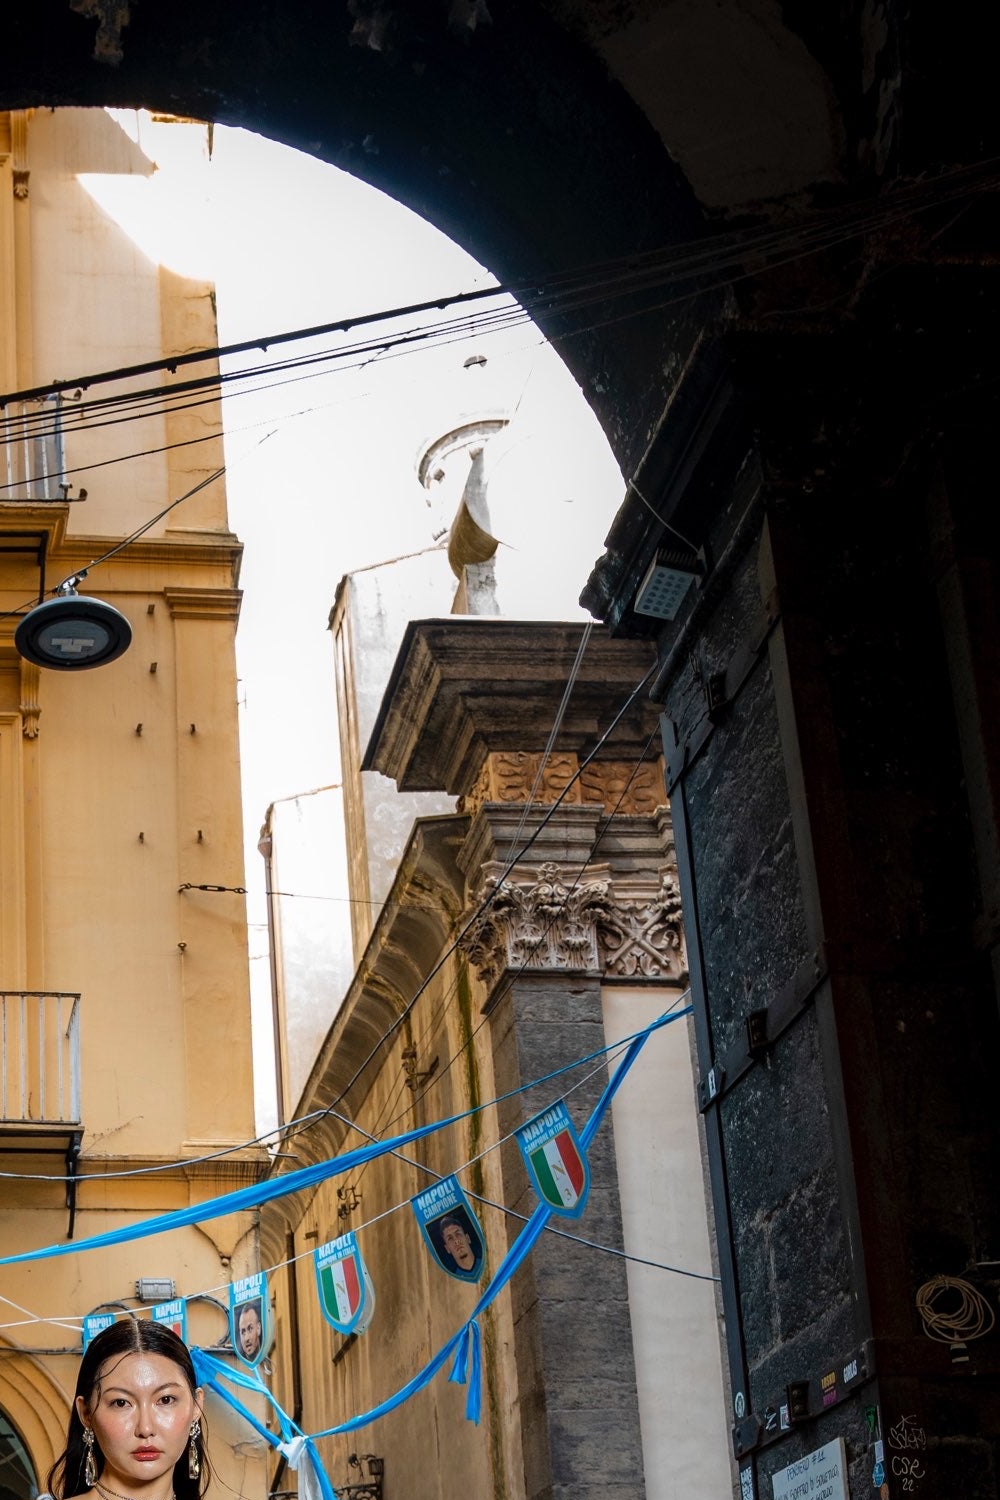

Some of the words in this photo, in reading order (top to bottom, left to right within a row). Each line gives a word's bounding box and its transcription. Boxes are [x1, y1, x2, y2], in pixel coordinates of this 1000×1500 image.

[521, 1105, 564, 1142] NAPOLI
[524, 1132, 549, 1154] CAMPIONE
[417, 1179, 455, 1210] NAPOLI
[423, 1192, 457, 1219] CAMPIONE
[318, 1232, 352, 1259] NAPOLI
[233, 1272, 263, 1294] NAPOLI
[87, 1315, 112, 1329] NAPOLI
[155, 1301, 181, 1319] NAPOLI
